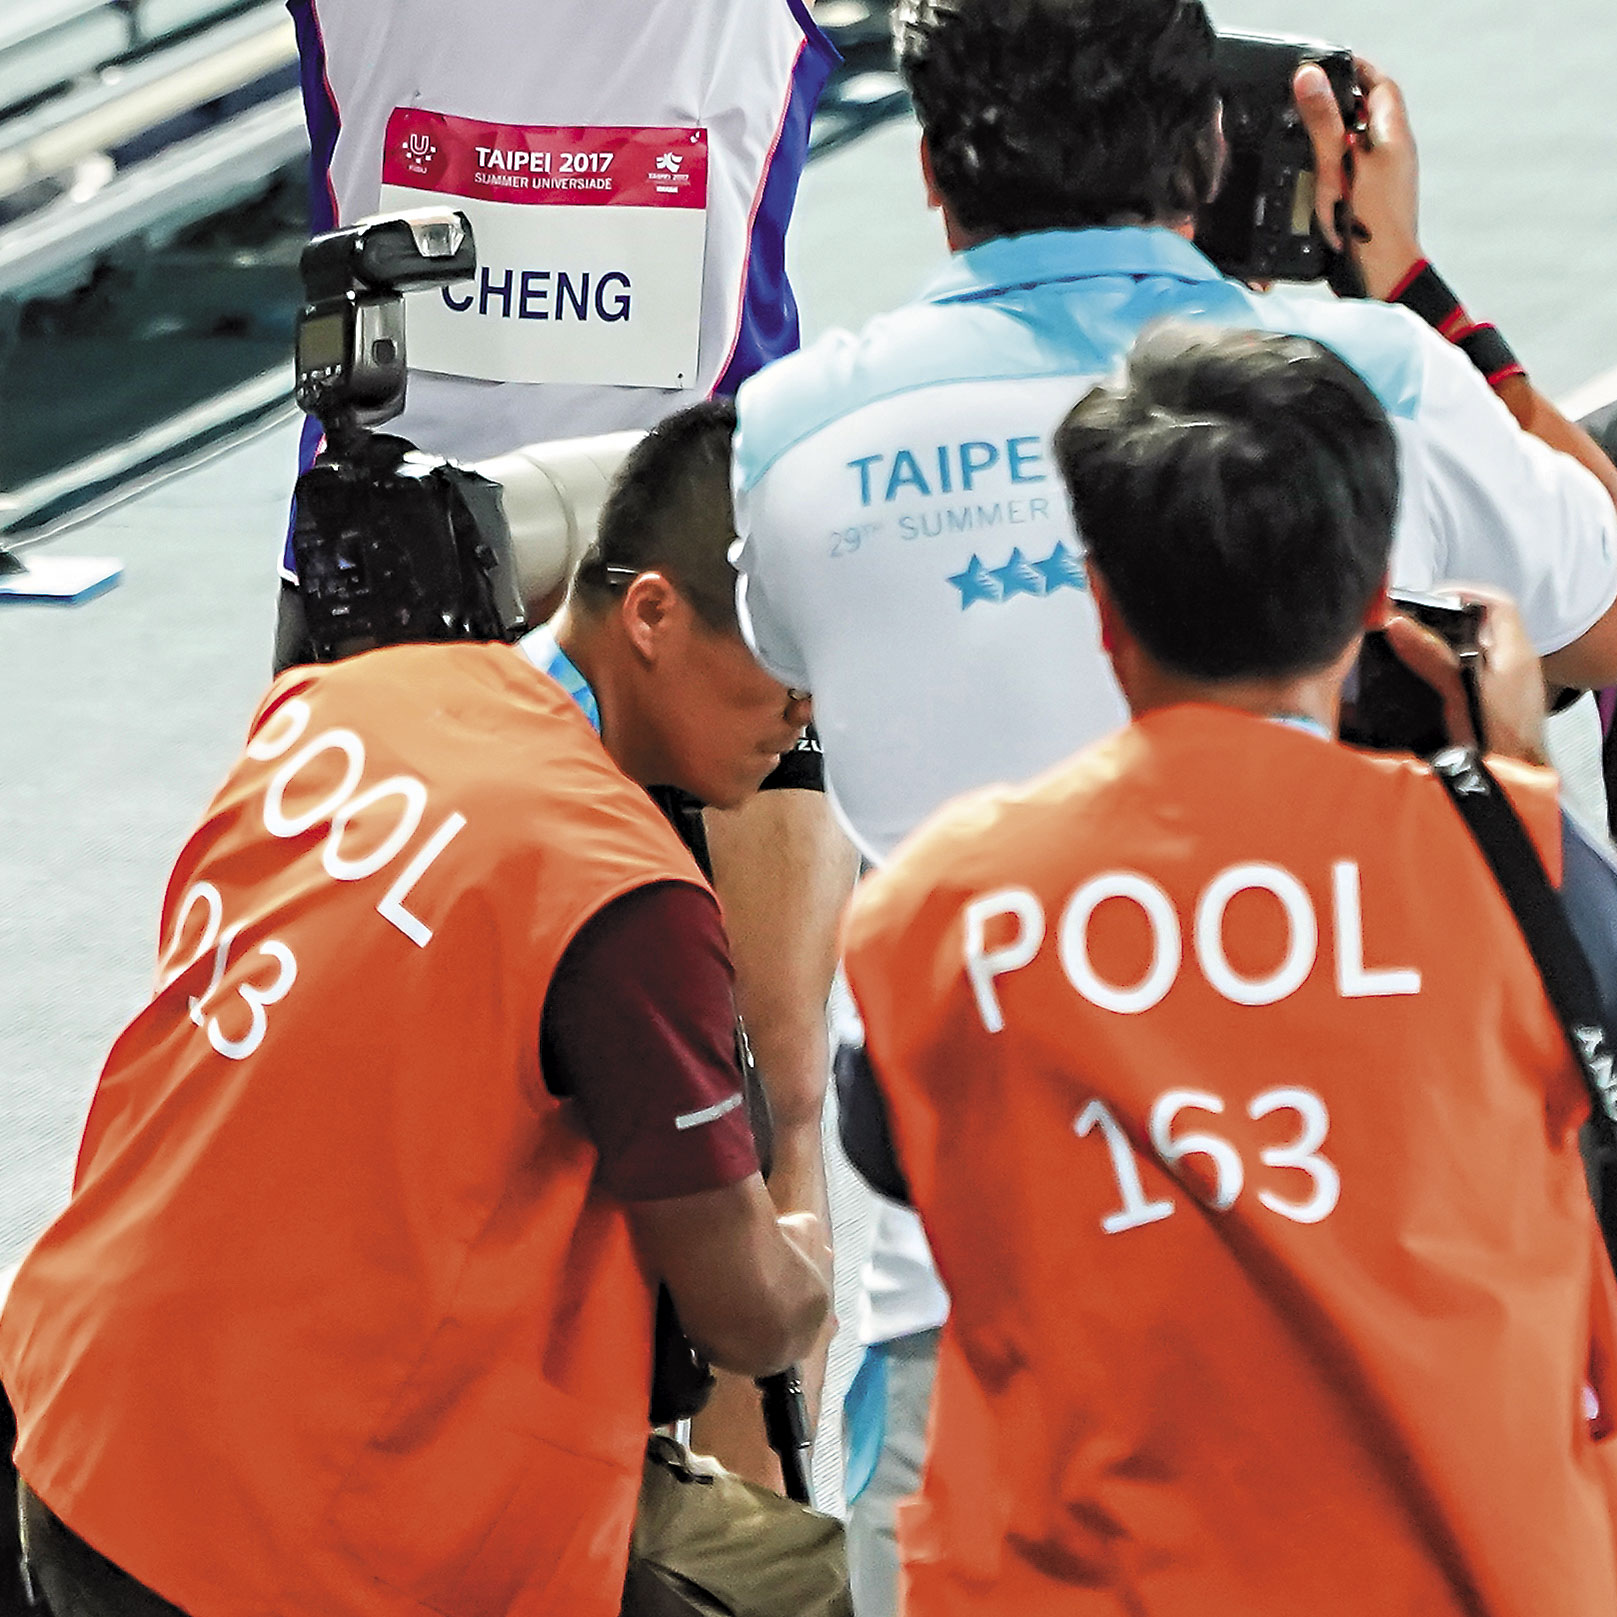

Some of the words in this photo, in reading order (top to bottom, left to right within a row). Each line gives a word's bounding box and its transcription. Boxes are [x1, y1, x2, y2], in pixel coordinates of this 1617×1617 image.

[474, 172, 529, 189] SUMMER
[532, 176, 613, 190] UNIVERSIADE
[475, 146, 552, 174] TAIPEI
[558, 152, 614, 174] 2017
[846, 435, 1047, 507] TAIPE
[898, 497, 1049, 541] SUMMER
[246, 698, 468, 949] POOL
[964, 859, 1422, 1033] POOL
